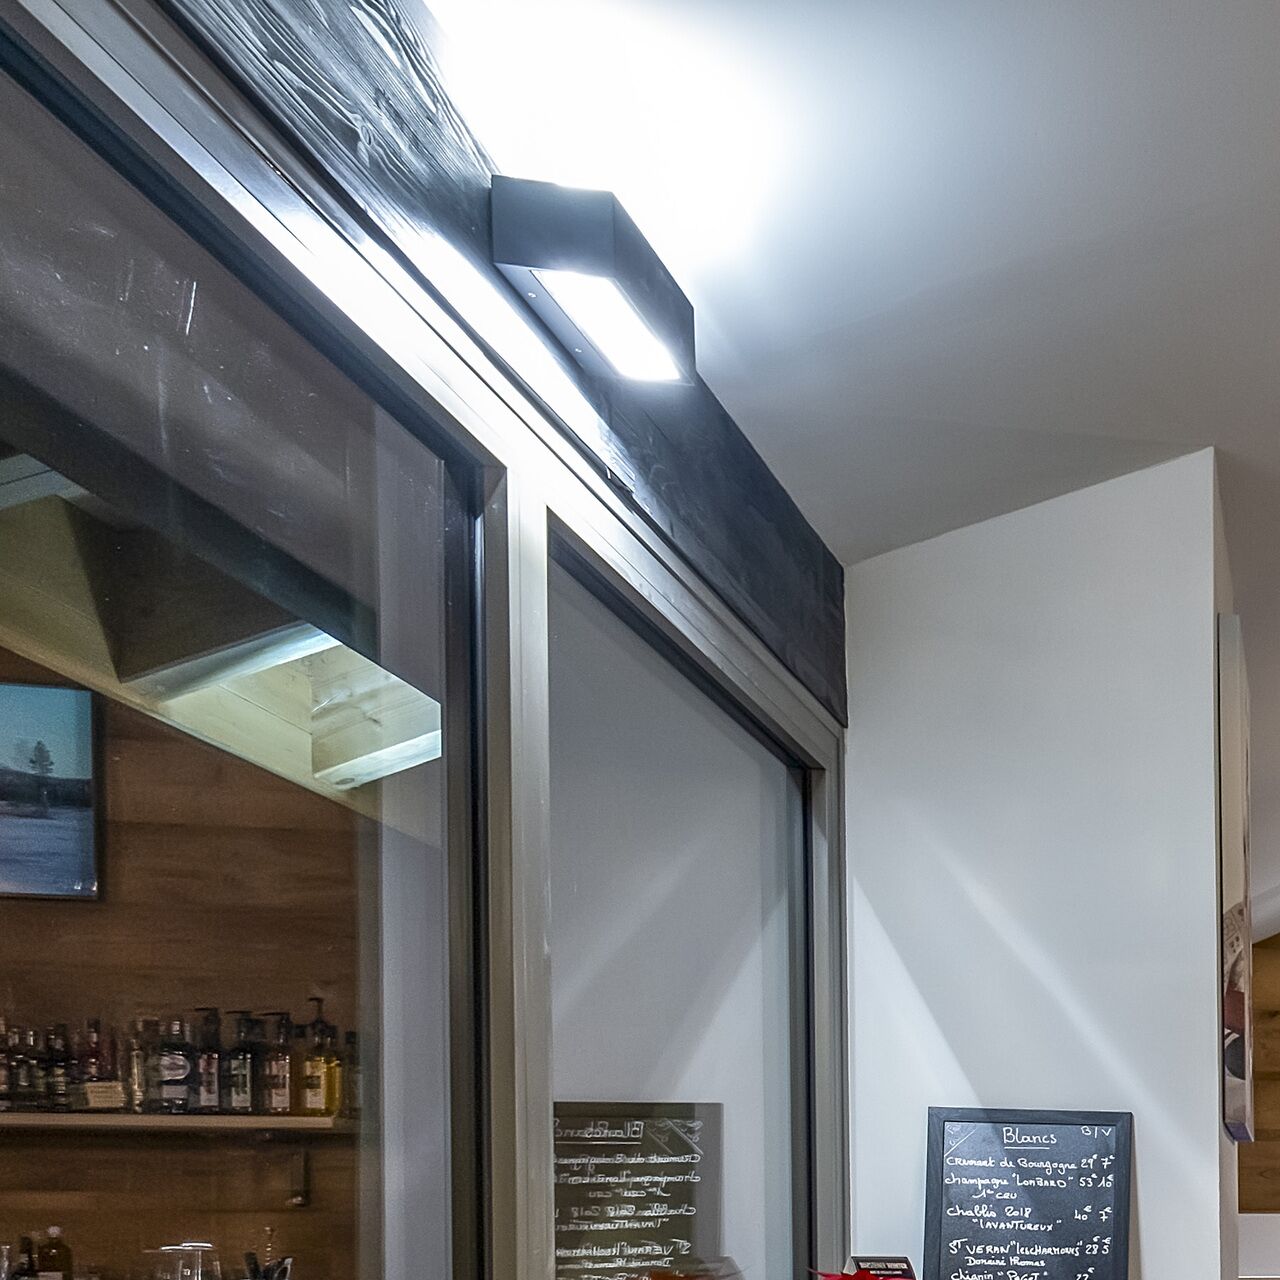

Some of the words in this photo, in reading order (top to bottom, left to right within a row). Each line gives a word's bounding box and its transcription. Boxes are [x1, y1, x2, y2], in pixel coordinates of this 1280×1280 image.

[1003, 1126, 1057, 1144] Blancs
[1000, 1156, 1016, 1169] de
[1017, 1157, 1079, 1176] Bourgogne
[1004, 1206, 1032, 1219] 2018
[966, 1242, 1010, 1255] VERAN
